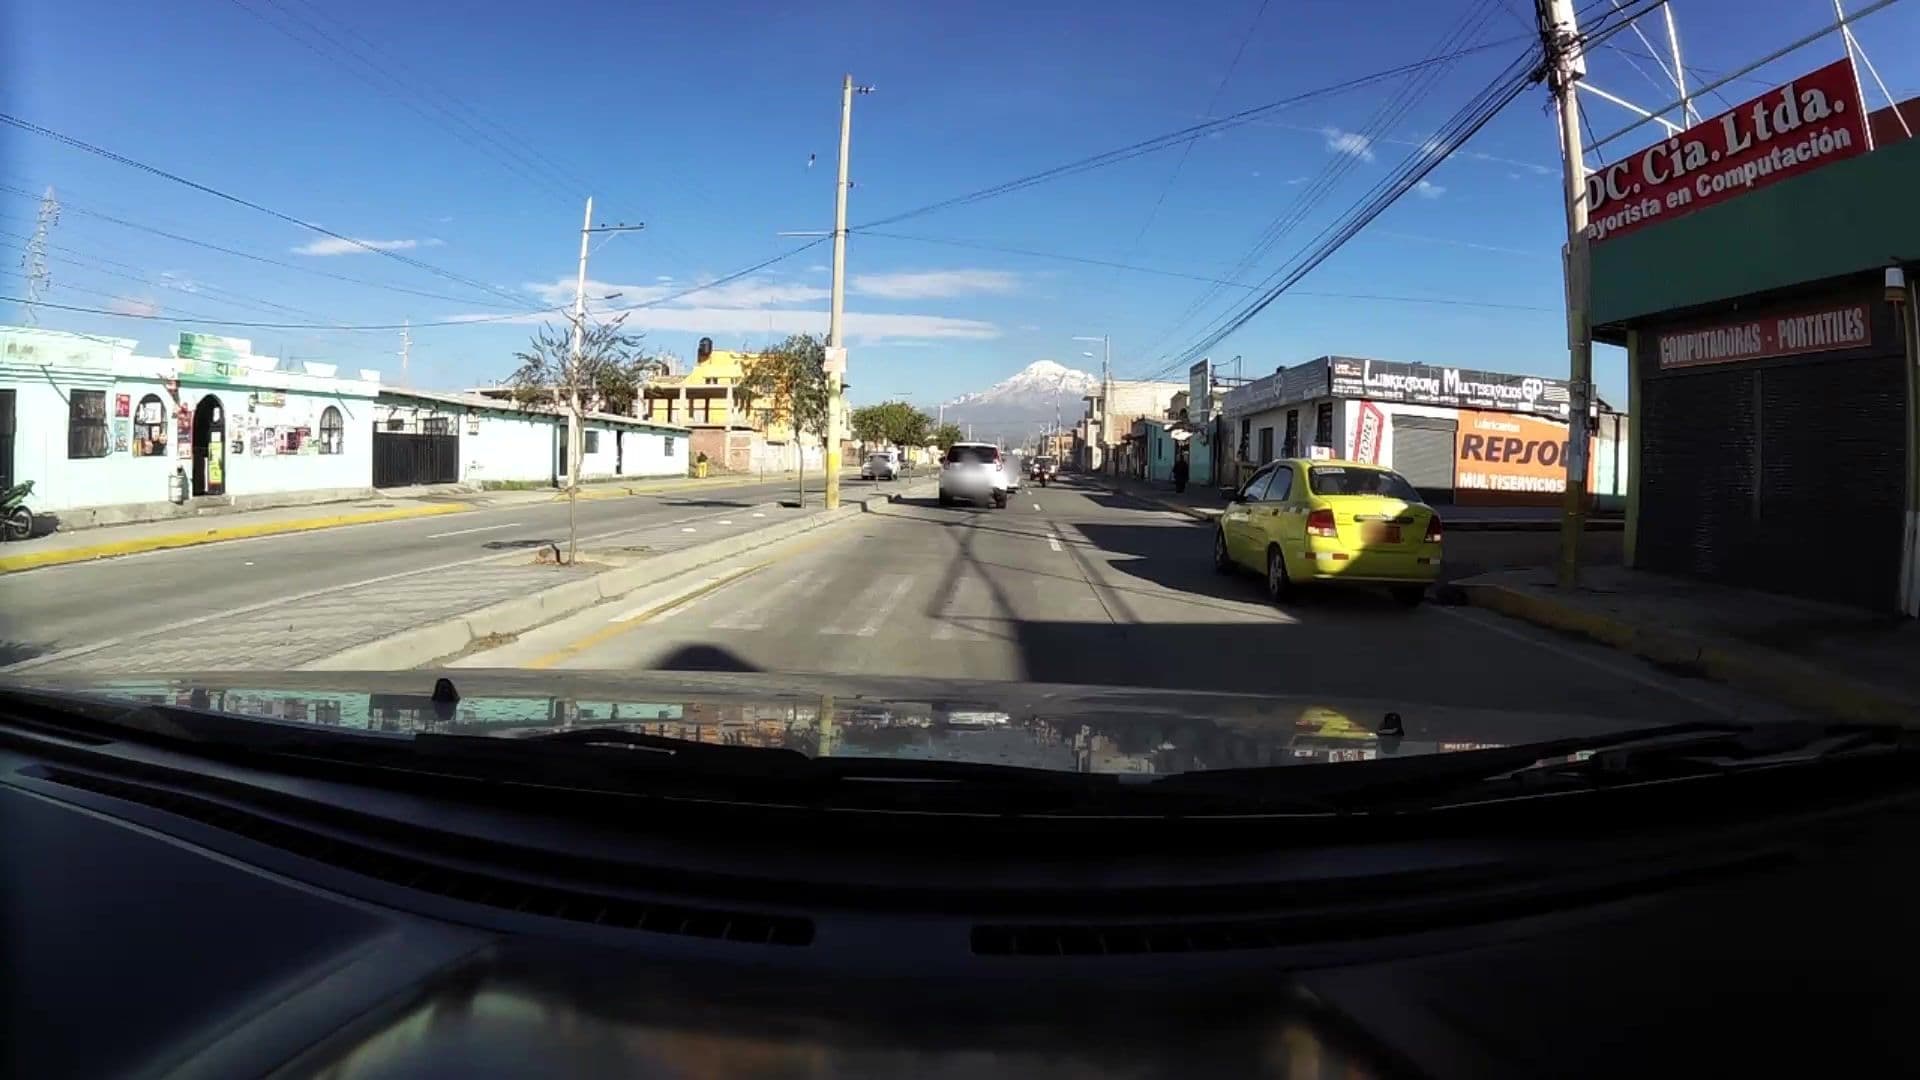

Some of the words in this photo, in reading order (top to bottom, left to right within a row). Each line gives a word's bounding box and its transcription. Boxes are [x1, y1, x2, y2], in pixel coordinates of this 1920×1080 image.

[1588, 198, 1661, 239] ayorista
[1666, 185, 1691, 208] en
[1696, 126, 1851, 194] Computación
[1660, 323, 1761, 364] COMPUTADORAS
[1777, 307, 1865, 350] PORTATILES
[1459, 472, 1567, 493] MULTISERVICIOS
